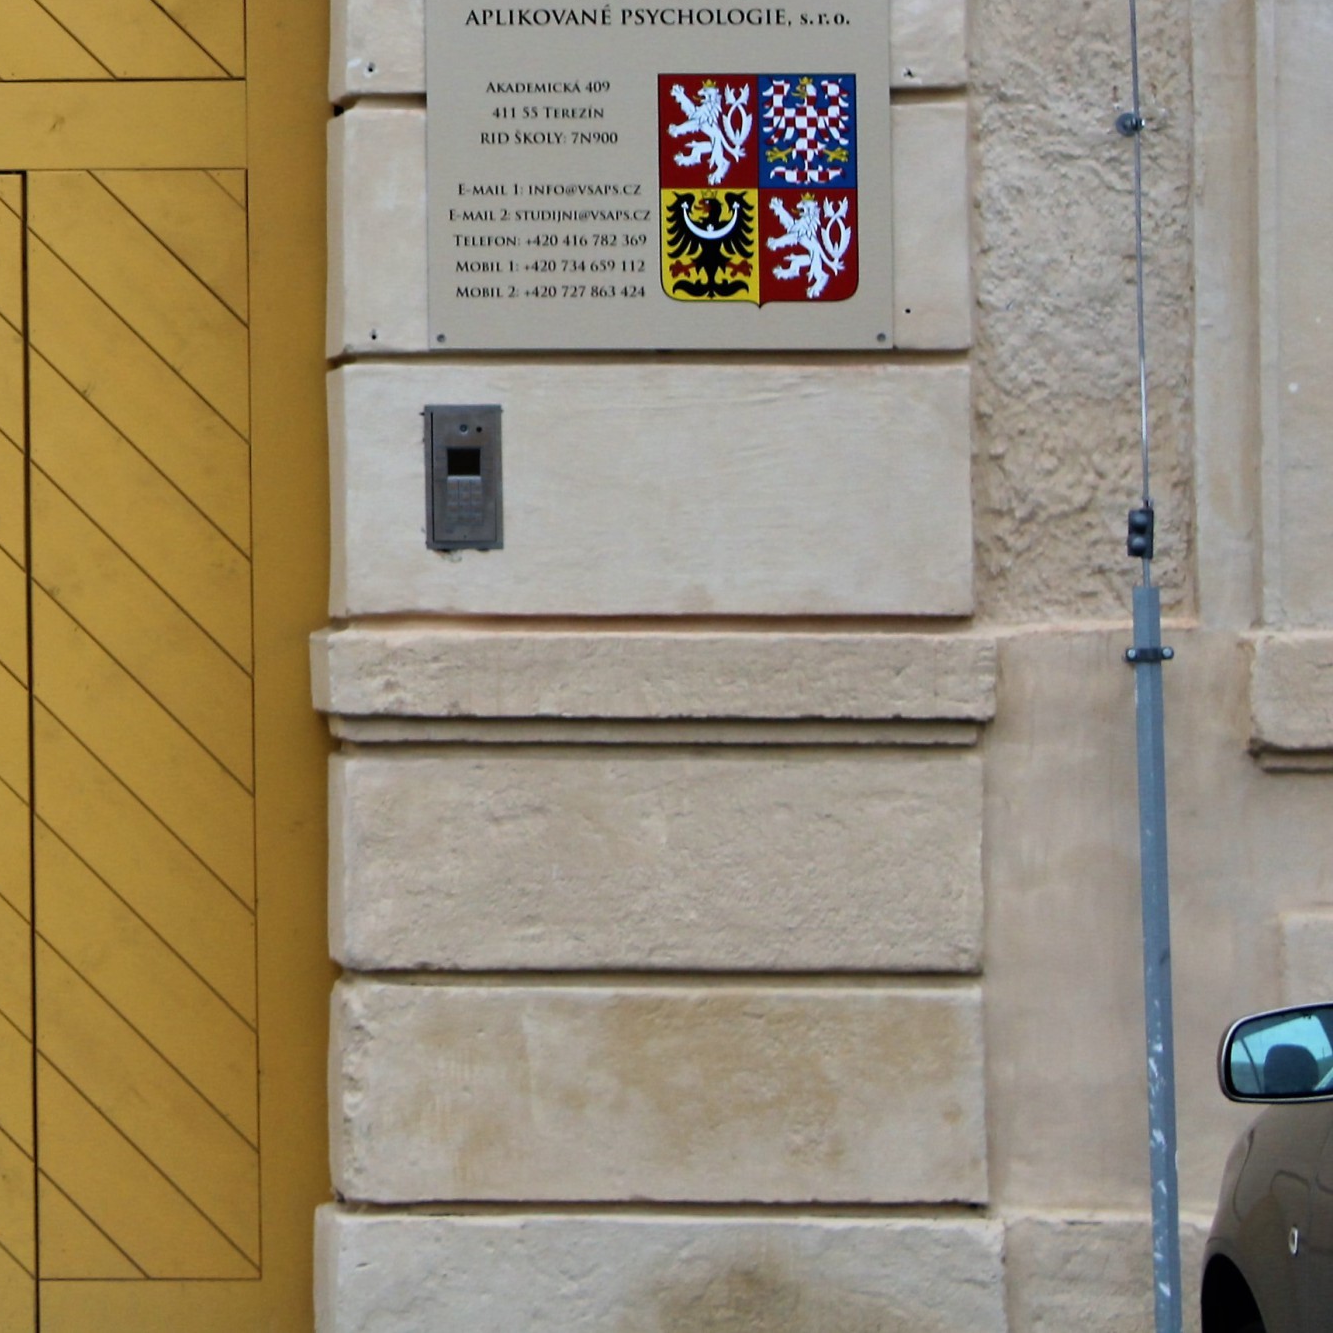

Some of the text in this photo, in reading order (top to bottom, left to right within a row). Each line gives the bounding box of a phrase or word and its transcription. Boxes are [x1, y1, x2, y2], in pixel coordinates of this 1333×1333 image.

[465, 4, 612, 27] APLIKOVANÉ
[621, 8, 792, 27] PSYCHOLOGIE,
[584, 80, 611, 94] 409
[492, 106, 516, 119] 411
[522, 105, 539, 119] 55
[480, 129, 619, 145] RID ŠKOLY: 7N900
[513, 183, 522, 196] 1:
[528, 184, 641, 196] INFO@VSAPS.CZ
[499, 208, 510, 222] 2:
[514, 209, 651, 224] STUDIJNI@VSAPS.CZ
[526, 234, 559, 247] +420
[562, 234, 589, 247] 416
[592, 233, 618, 247] 782
[621, 233, 648, 247] 369
[509, 260, 518, 273] 1:
[524, 259, 557, 273] +420
[561, 259, 586, 273] 734
[589, 259, 616, 273] 659
[621, 259, 646, 273] 112
[507, 285, 518, 299] 2:
[524, 285, 558, 299] +420
[561, 285, 587, 299] 727
[590, 285, 617, 298] 863
[620, 285, 646, 298] 424
